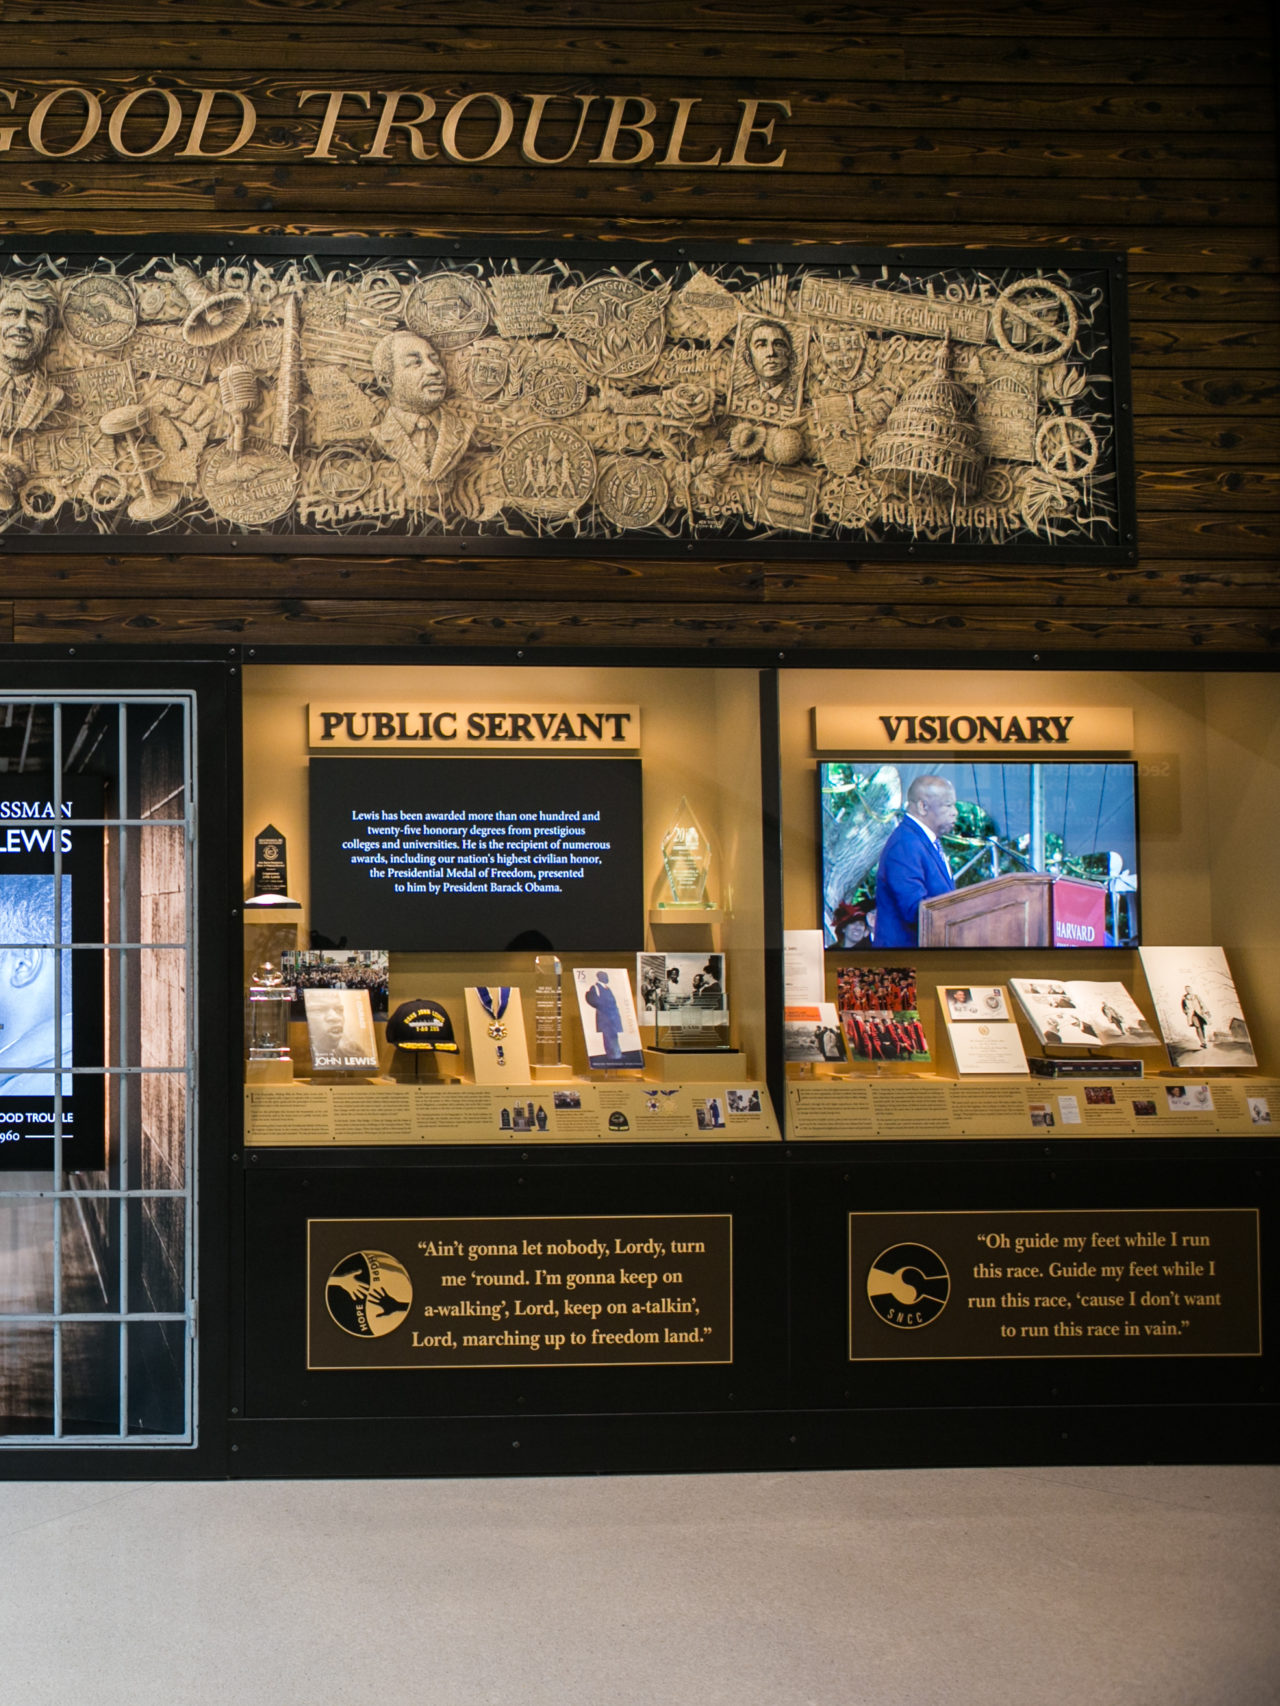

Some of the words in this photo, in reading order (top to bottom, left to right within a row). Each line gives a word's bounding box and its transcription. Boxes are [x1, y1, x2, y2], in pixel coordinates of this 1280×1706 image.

[298, 90, 792, 169] TROUBLE
[927, 282, 993, 304] LOVE
[810, 283, 840, 320] John
[847, 297, 885, 322] Lewis
[890, 301, 948, 332] Freedom
[732, 401, 795, 420] HOPE
[296, 487, 408, 526] Family
[881, 501, 950, 532] HUMAN
[955, 504, 1022, 532] RIGHTS
[320, 711, 458, 742] PUBLIC
[466, 712, 631, 742] SERVANT
[878, 714, 1074, 744] VISIONARY
[352, 810, 380, 820] Lewis
[381, 810, 398, 820] has
[399, 810, 423, 820] been
[424, 810, 466, 820] awarded
[495, 810, 517, 820] than
[539, 810, 580, 821] hundred
[582, 810, 600, 821] and
[1055, 920, 1095, 942] HARVARD
[315, 1056, 342, 1066] JOHN
[344, 1057, 377, 1066] LEWIS
[25, 1112, 73, 1123] TROULE
[468, 1244, 518, 1261] gonna
[522, 1240, 542, 1255] let
[546, 1238, 610, 1259] nobody,
[614, 1238, 665, 1258] Lordy,
[670, 1240, 704, 1253] turn
[1014, 1233, 1058, 1253] guide
[1063, 1237, 1086, 1252] my
[1091, 1232, 1120, 1247] feet
[1124, 1232, 1166, 1246] while
[1170, 1231, 1176, 1246] I
[1182, 1236, 1210, 1246] run
[355, 1304, 368, 1332] HOPE
[887, 1308, 924, 1326] SNCC
